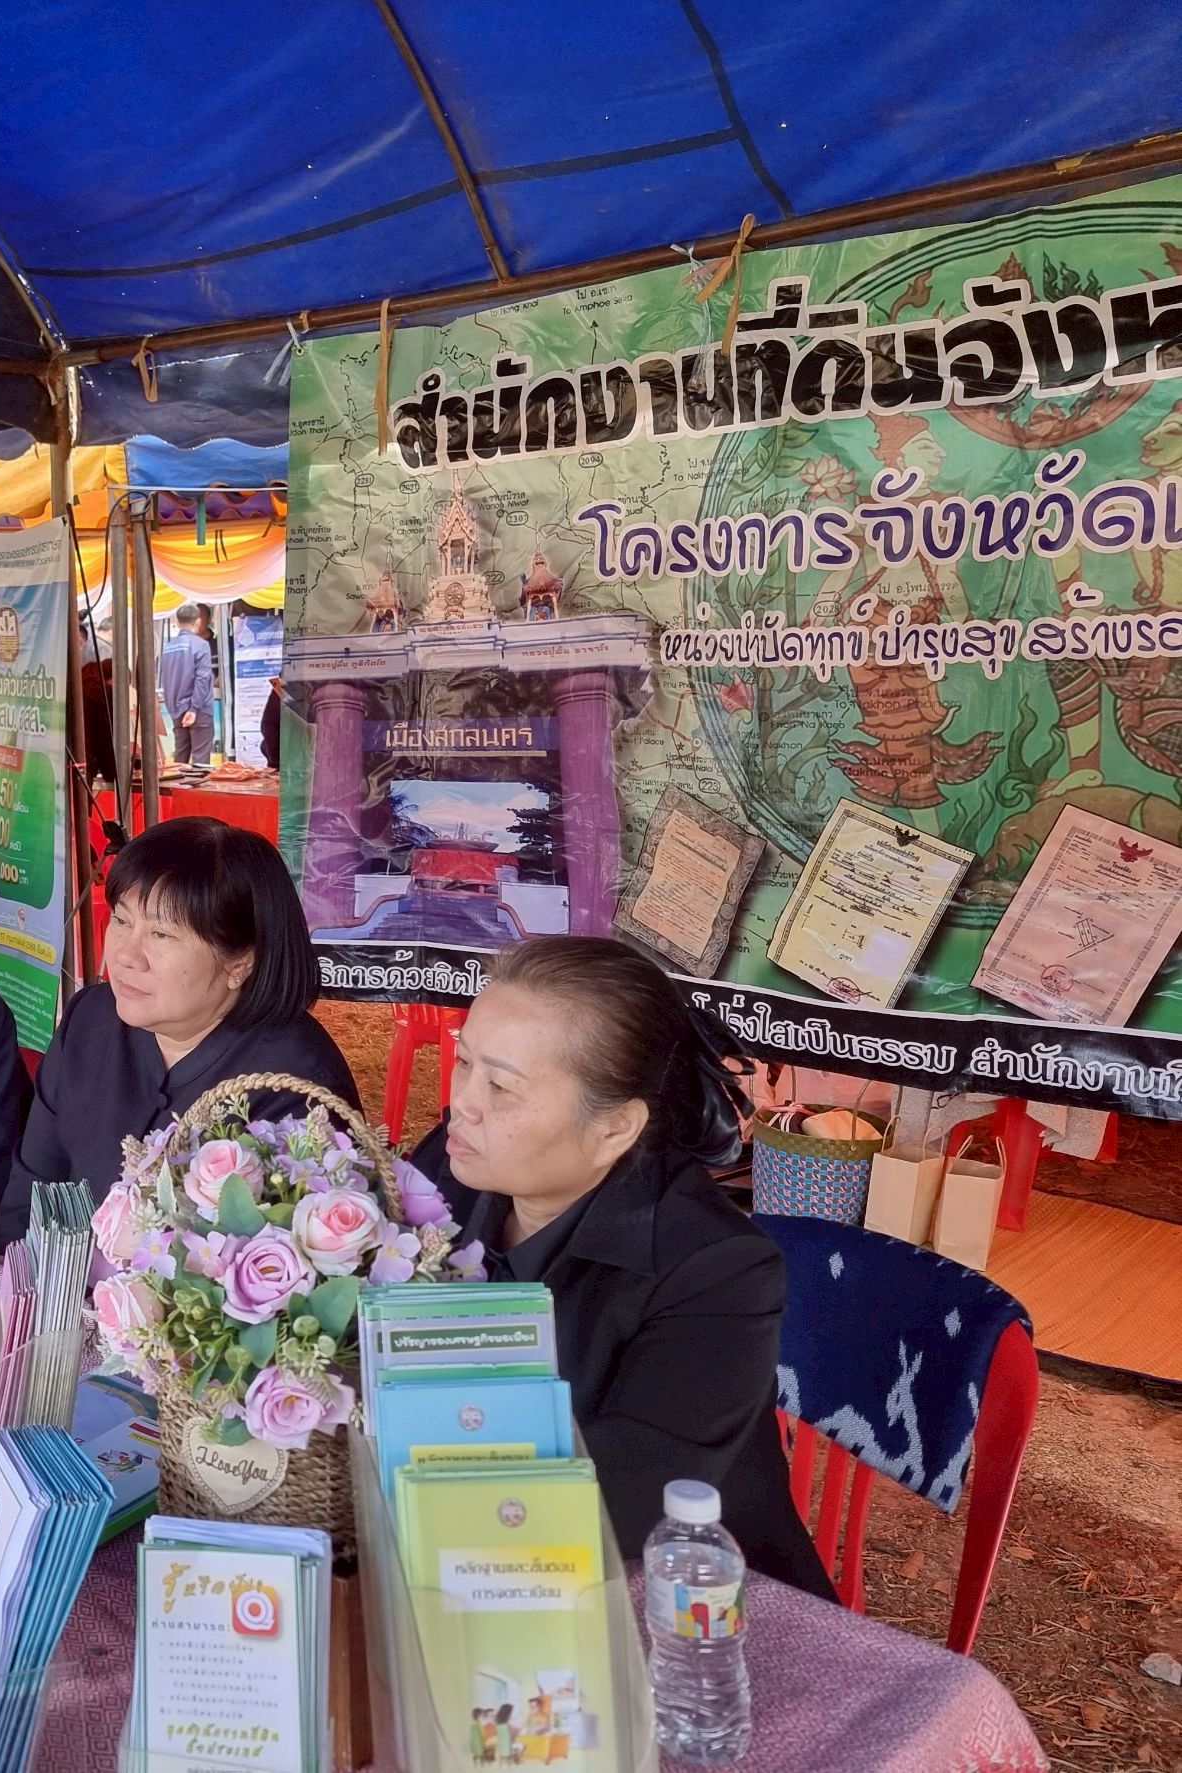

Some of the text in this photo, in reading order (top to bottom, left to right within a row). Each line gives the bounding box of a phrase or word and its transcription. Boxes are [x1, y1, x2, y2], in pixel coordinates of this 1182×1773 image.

[563, 306, 573, 316] To
[574, 299, 611, 315] Amphoe
[309, 426, 329, 435] Thani
[674, 473, 685, 483] To
[506, 499, 530, 510] Niwat
[306, 534, 333, 543] Phibun
[877, 582, 889, 594] ไป
[663, 597, 871, 678] หน่วยบำบัดทุกข์
[879, 611, 1017, 675] บำรุงสุข
[385, 721, 534, 748] เมืองสกลนคร
[701, 781, 719, 791] 223
